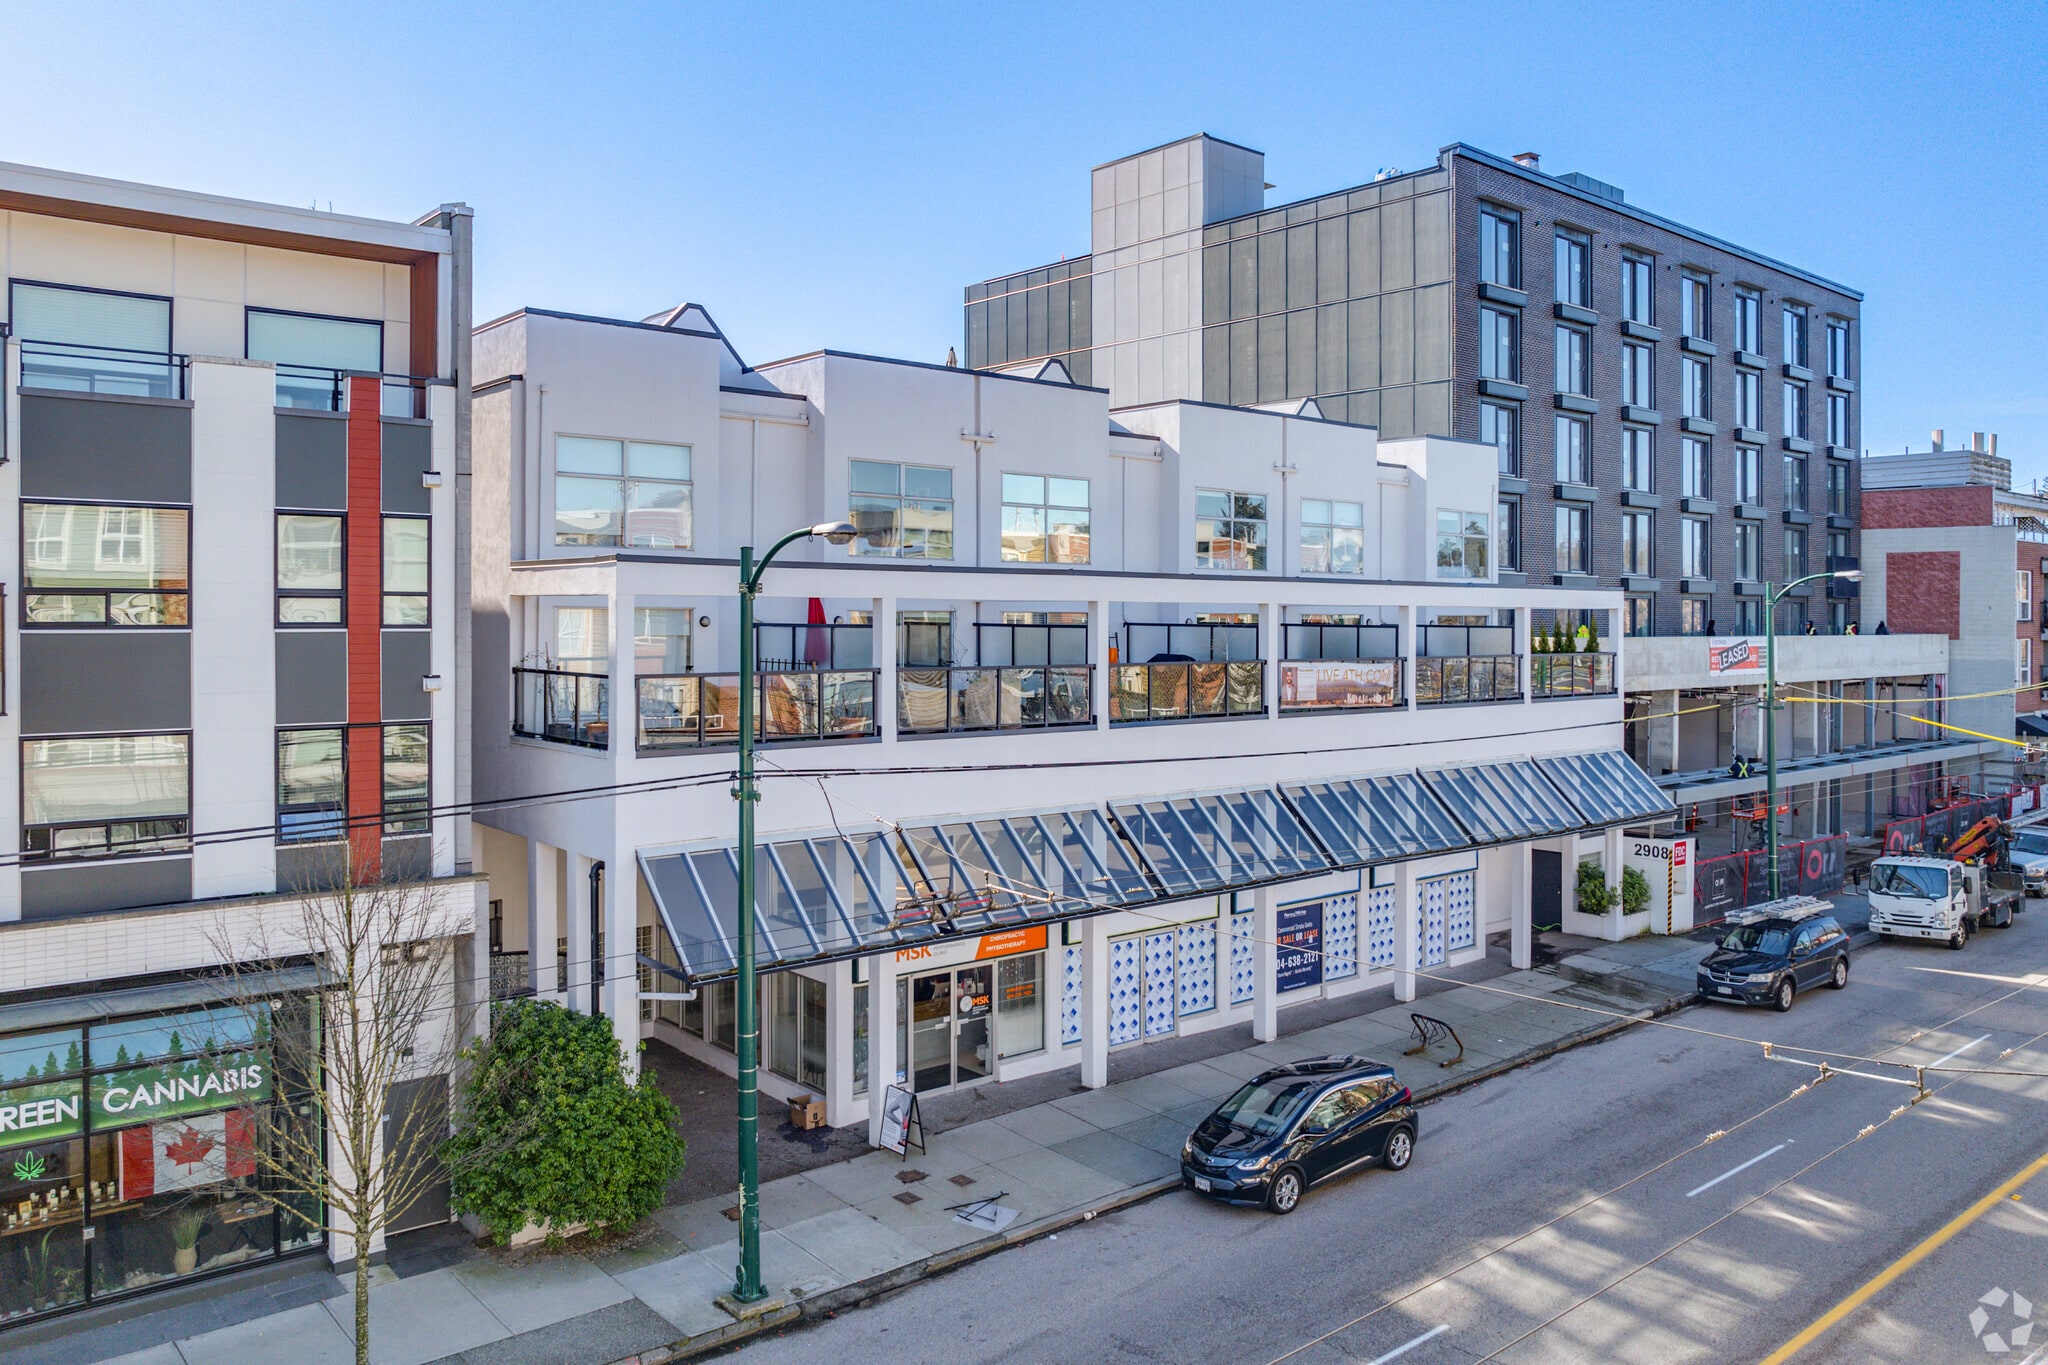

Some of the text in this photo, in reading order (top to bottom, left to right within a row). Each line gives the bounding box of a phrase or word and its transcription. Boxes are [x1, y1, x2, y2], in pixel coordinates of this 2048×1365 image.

[1720, 643, 1748, 669] LEASED
[1317, 669, 1391, 683] LIVE 4TH.COM
[1634, 843, 1669, 860] 2908
[989, 931, 1026, 942] CHIROPRACTIC
[1283, 934, 1295, 944] SALE
[1295, 932, 1303, 941] OR
[1304, 929, 1318, 940] LEASE
[985, 940, 1026, 952] PHYSIOTHERAPY
[896, 946, 931, 963] MSK
[972, 995, 990, 1006] MSK
[103, 1065, 262, 1113] CANNABIS
